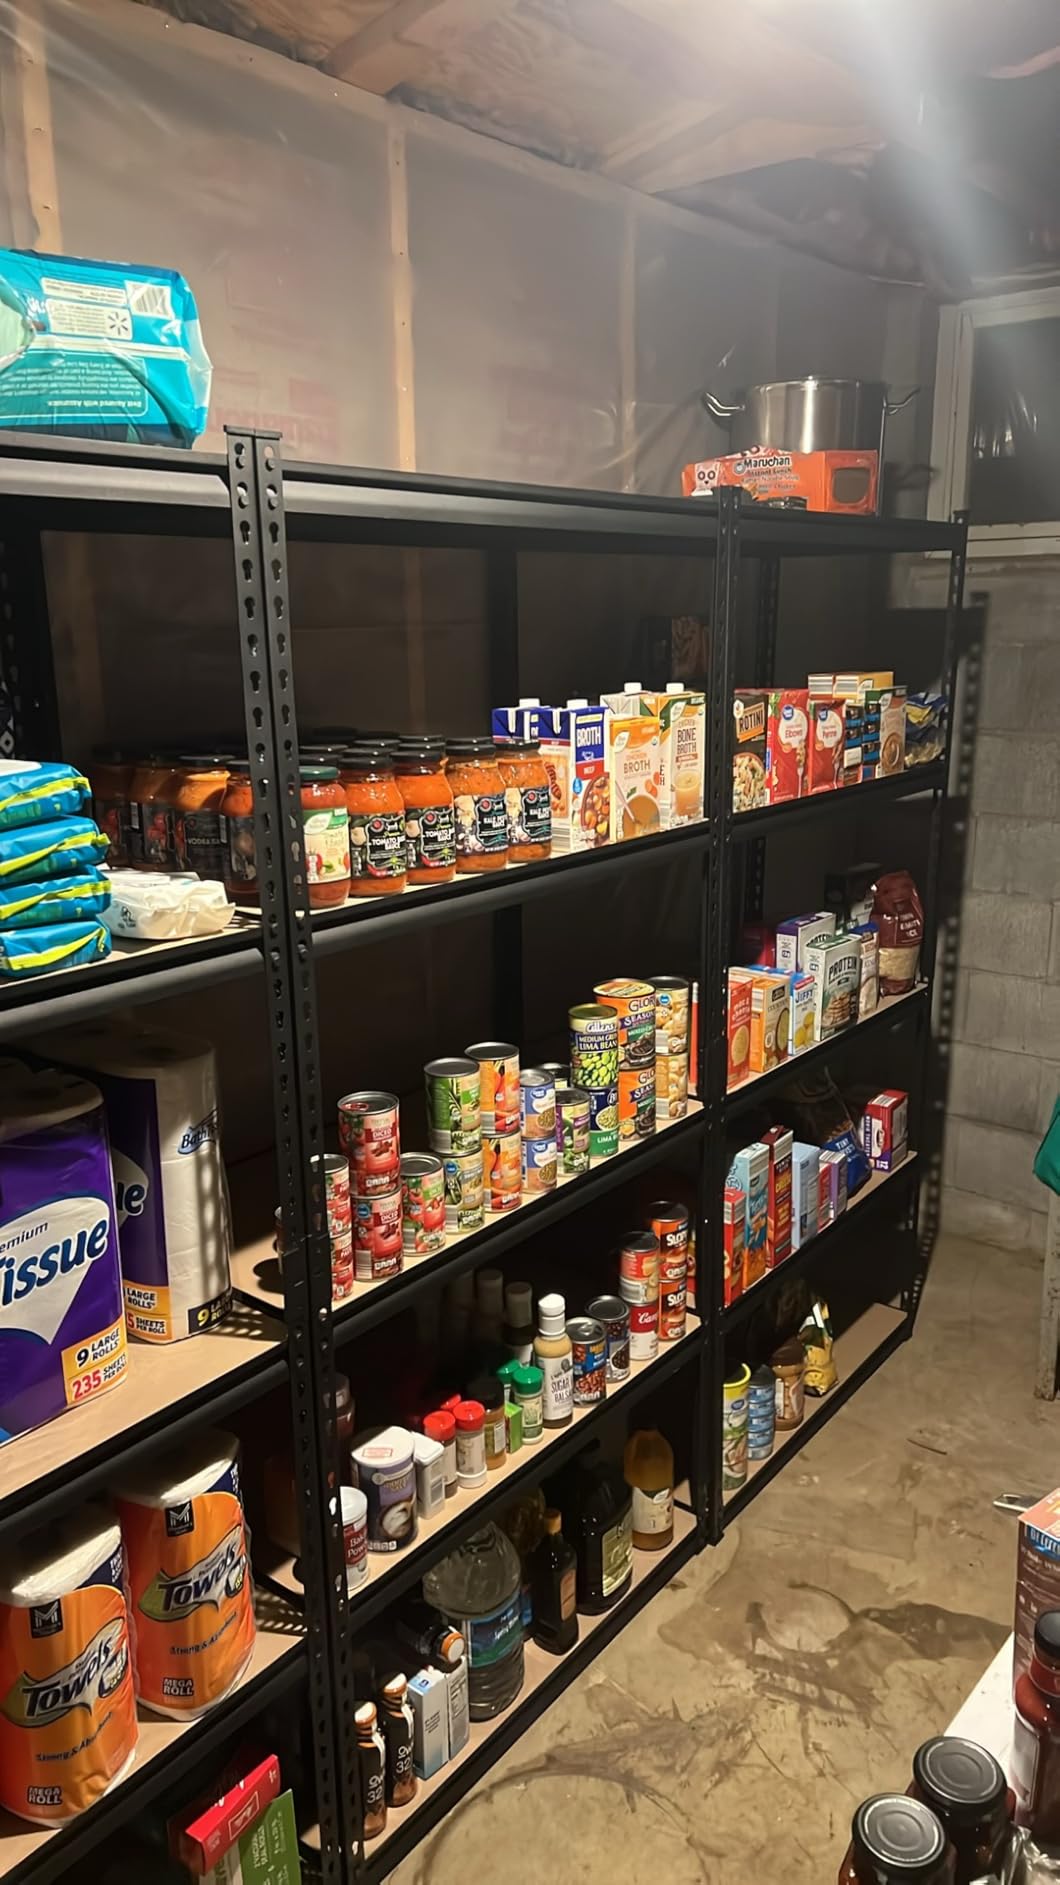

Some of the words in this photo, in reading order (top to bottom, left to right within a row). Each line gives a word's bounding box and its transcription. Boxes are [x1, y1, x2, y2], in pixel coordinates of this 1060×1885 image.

[744, 456, 790, 468] Maruchan
[740, 710, 764, 733] ROTINI
[576, 726, 602, 748] BROTH
[677, 728, 697, 742] BONE
[677, 742, 697, 755] BROTH
[623, 760, 651, 774] BROTH
[829, 957, 857, 985] PROTEIN
[795, 989, 813, 1003] JIFFY
[579, 1034, 605, 1043] MEDIUM
[579, 1042, 599, 1051] LIMA
[373, 1129, 392, 1138] DICED
[597, 1136, 612, 1144] LIMA
[381, 1211, 398, 1220] DICED
[127, 1287, 156, 1301] LARGE
[135, 1317, 165, 1328] SHEETS
[197, 1308, 209, 1327] 9
[91, 1327, 120, 1352] LARGE
[76, 1348, 90, 1368] 9
[92, 1339, 119, 1361] ROLLS
[72, 1369, 102, 1399] 235
[551, 1377, 570, 1394] SUGAR
[157, 1542, 236, 1612] Towels
[21, 1637, 113, 1718] Towels
[163, 1678, 193, 1687] MEGA
[163, 1686, 193, 1696] ROLL
[396, 1757, 411, 1774] 32
[28, 1786, 61, 1795] MEGA
[367, 1785, 383, 1804] 32
[28, 1794, 61, 1805] ROLL
